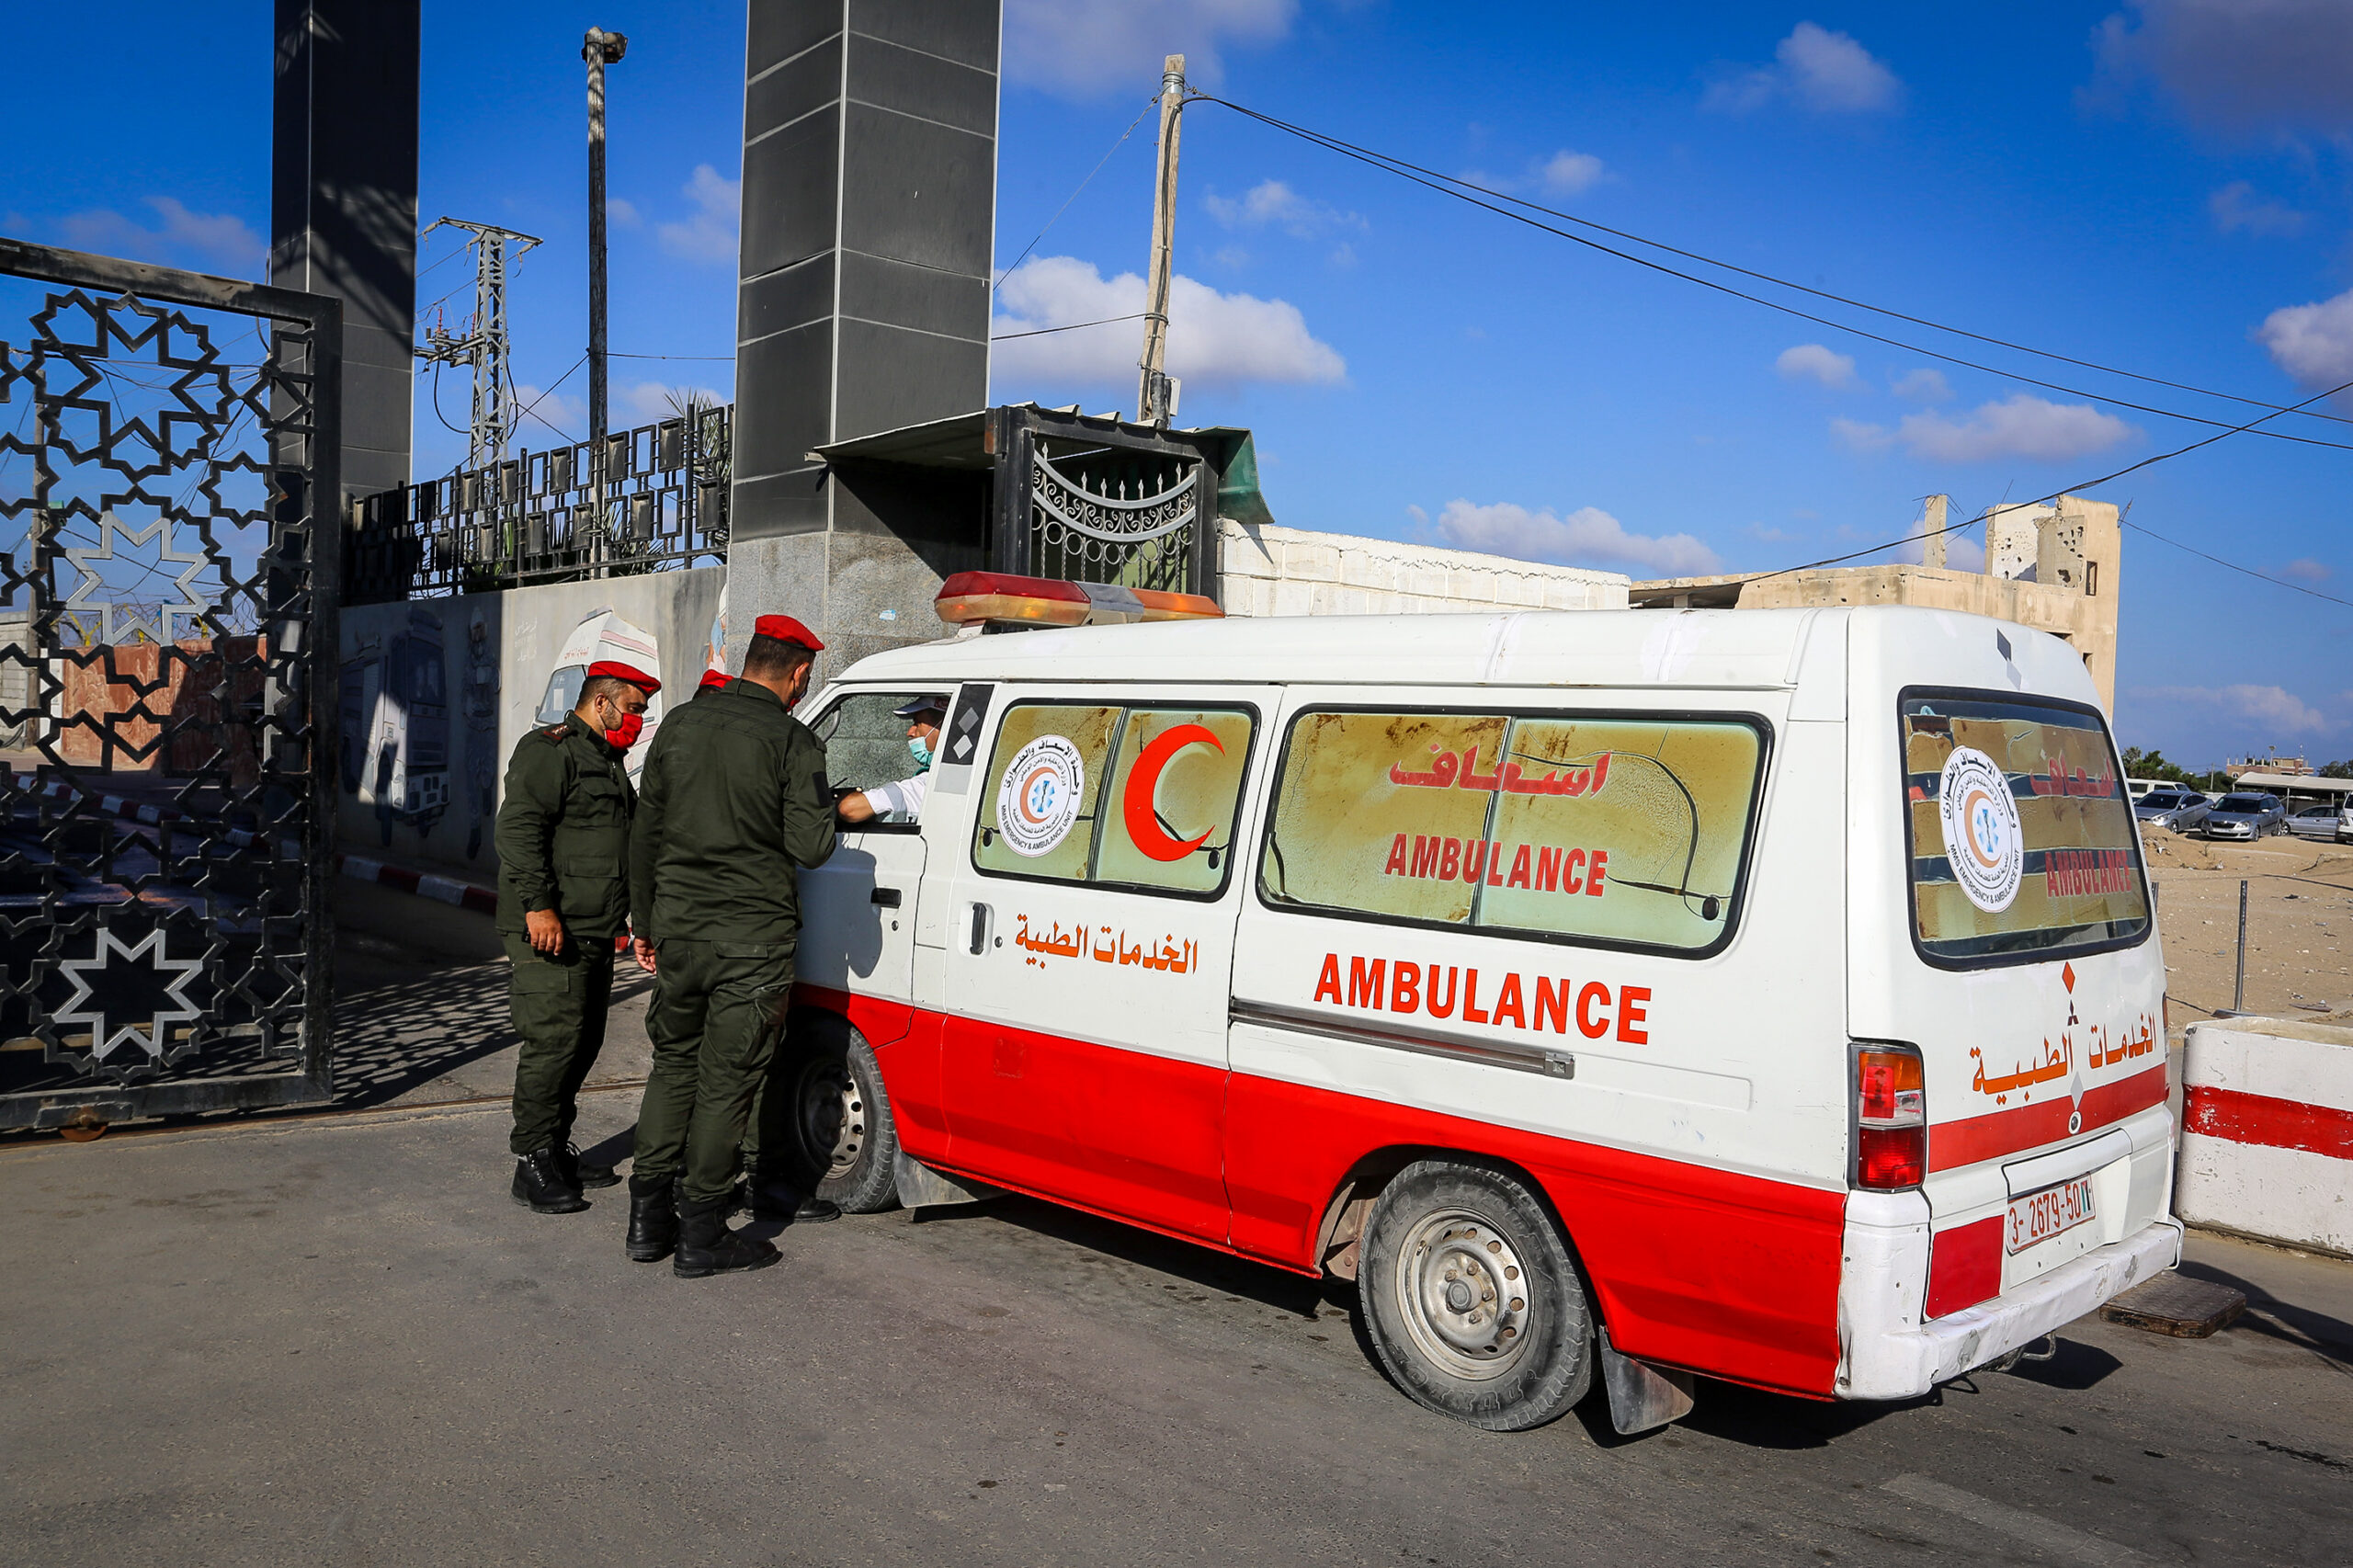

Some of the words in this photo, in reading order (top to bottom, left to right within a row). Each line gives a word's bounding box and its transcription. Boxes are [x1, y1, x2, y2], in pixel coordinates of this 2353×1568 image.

[1003, 820, 1028, 849] EMERGENCY
[1032, 828, 1063, 850] AMBULANCE
[1063, 810, 1074, 827] UNIT
[1385, 833, 1608, 897] AMBULANCE
[1959, 866, 1990, 903] EMERGENCY
[1995, 869, 2018, 903] AMBULANCE
[2045, 850, 2131, 898] AMBULANCE
[1015, 913, 1089, 970] الطبية
[1093, 926, 1199, 975] الخدمات
[1313, 952, 1653, 1045] AMBULANCE
[1969, 1028, 2074, 1106] الطبية
[2088, 1011, 2157, 1070] الخدمات
